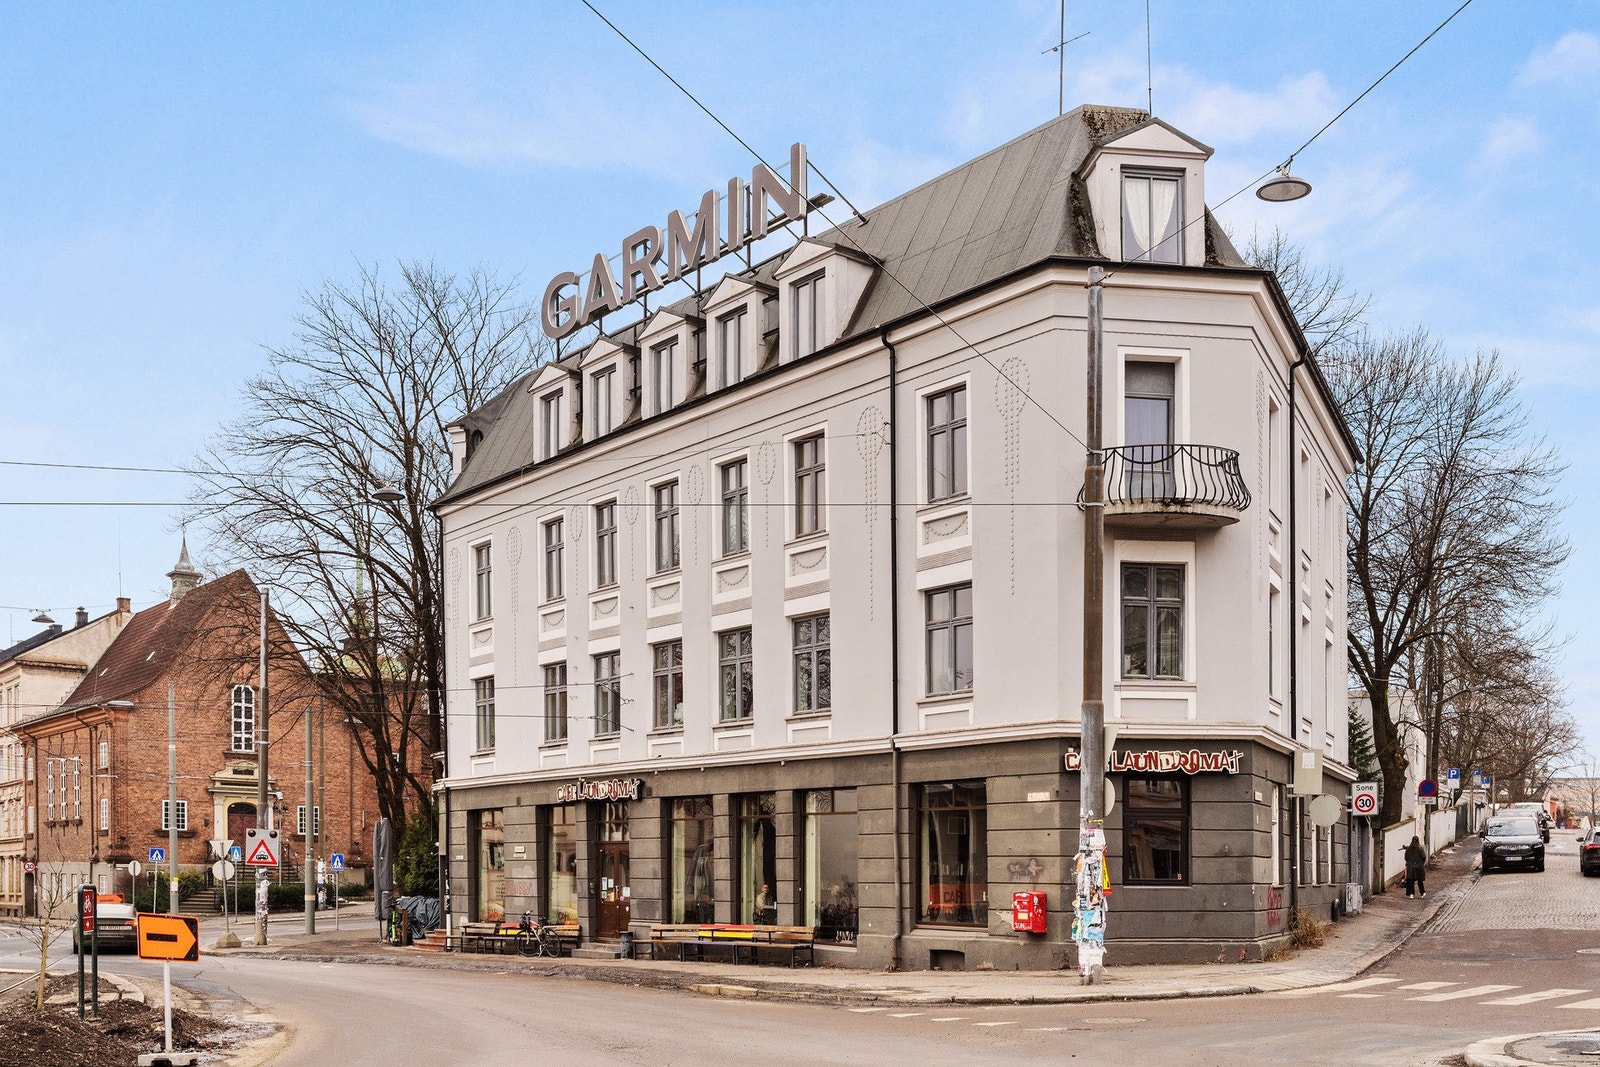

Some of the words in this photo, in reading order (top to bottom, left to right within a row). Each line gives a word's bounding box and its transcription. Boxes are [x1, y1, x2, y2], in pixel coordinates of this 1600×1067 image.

[541, 142, 806, 339] GARMIN
[1112, 749, 1244, 774] LAUNDROMAT
[1450, 769, 1457, 778] P
[577, 779, 640, 801] LAUNDROMAT
[1355, 784, 1374, 792] Sone
[1359, 798, 1371, 808] 30
